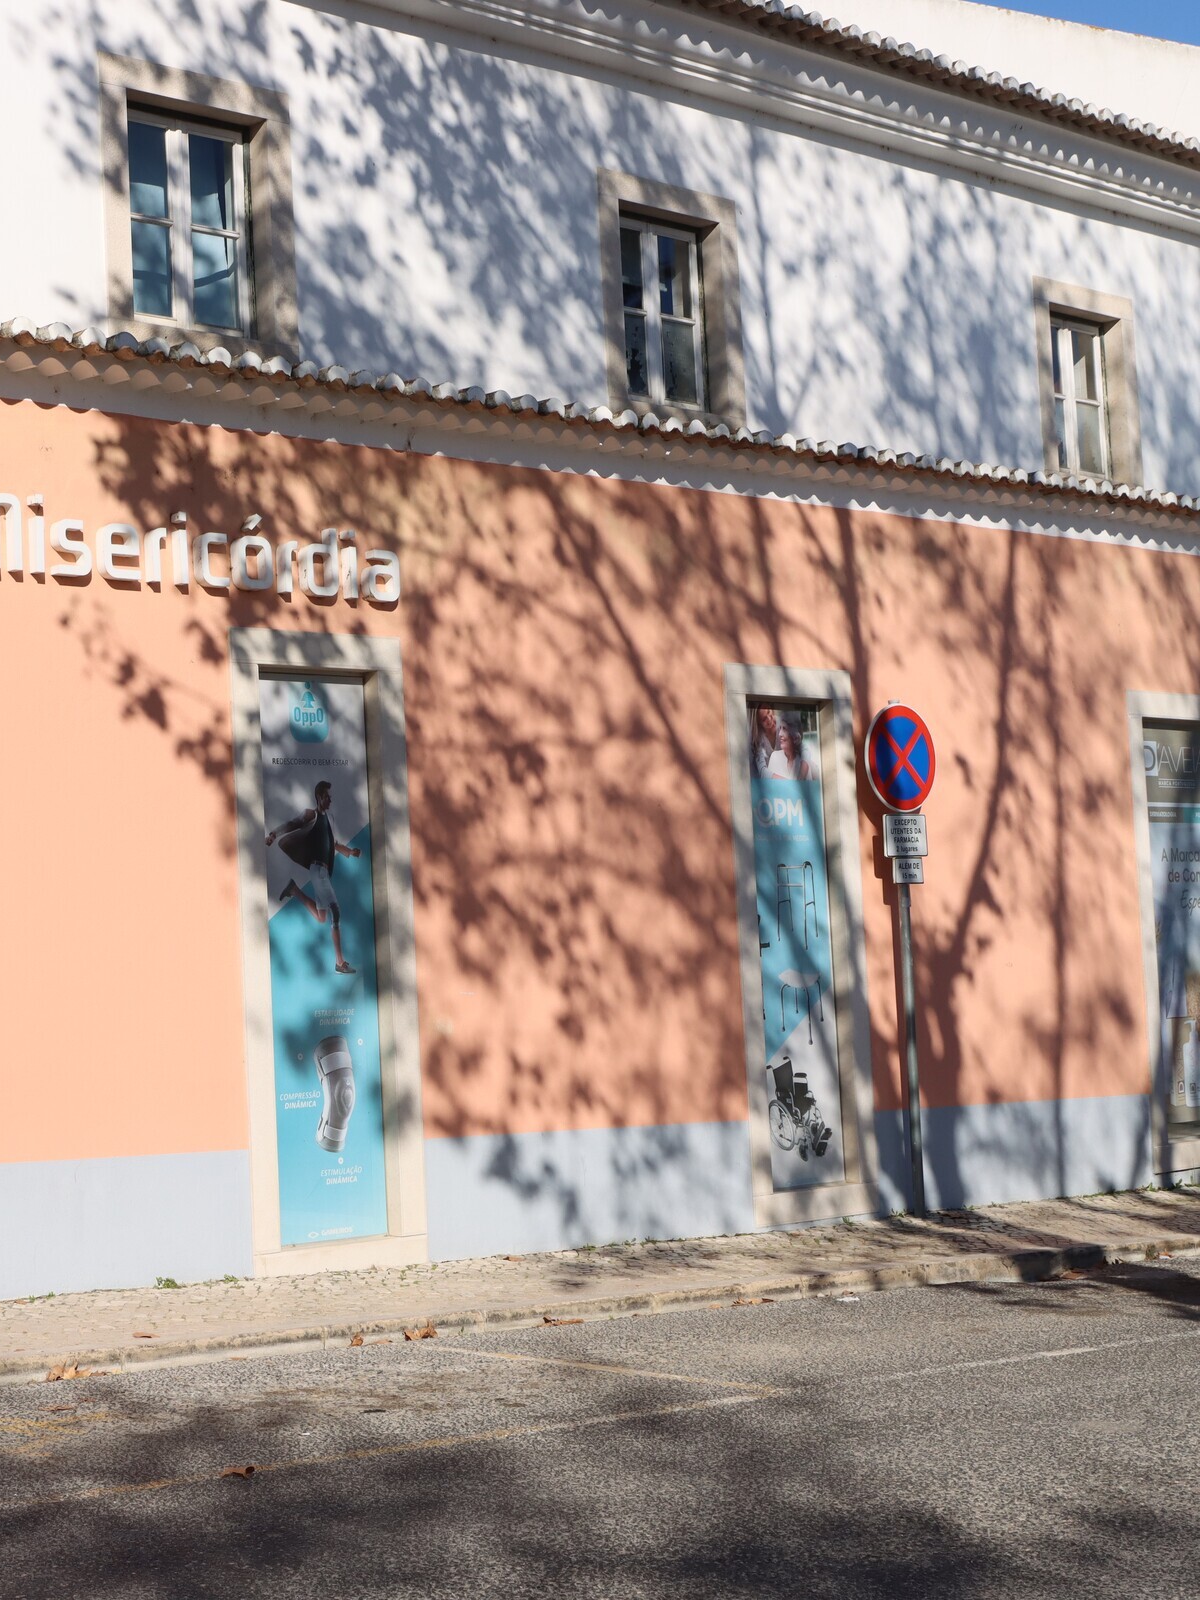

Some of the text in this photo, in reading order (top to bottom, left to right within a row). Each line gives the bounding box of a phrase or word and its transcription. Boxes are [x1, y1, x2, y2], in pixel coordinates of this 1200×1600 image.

[894, 818, 917, 826] EXCEPTO
[1161, 848, 1168, 862] A
[1168, 868, 1180, 883] de
[314, 1008, 355, 1017] ESTABILIDADE
[280, 1090, 320, 1101] COMPRESSÃO
[284, 1100, 317, 1109] DINÂMICA
[321, 1165, 362, 1177] ESTIMULAÇÃO
[326, 1175, 358, 1185] DINÂMICA
